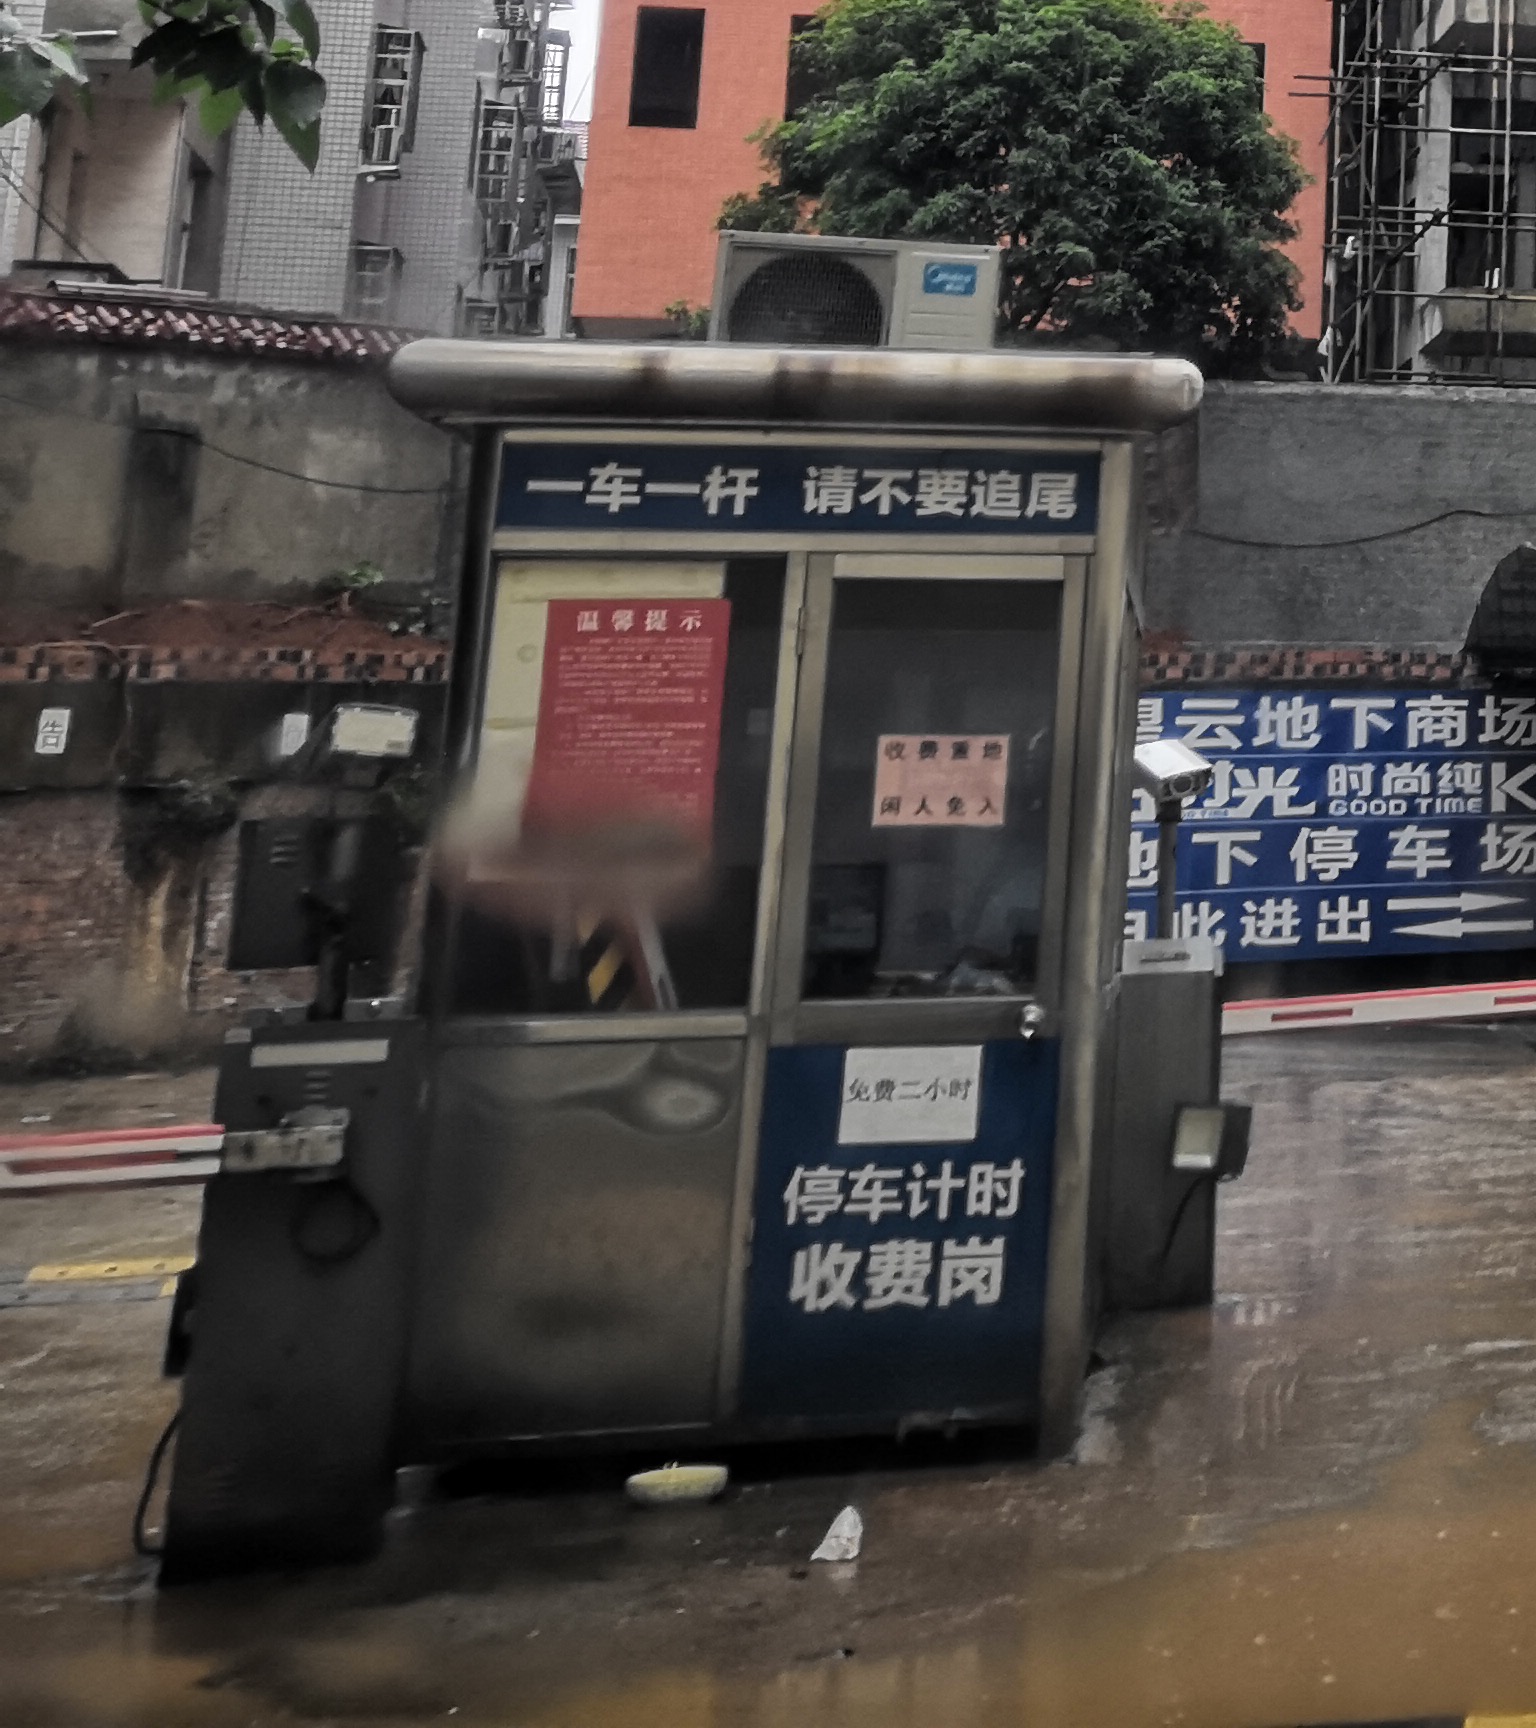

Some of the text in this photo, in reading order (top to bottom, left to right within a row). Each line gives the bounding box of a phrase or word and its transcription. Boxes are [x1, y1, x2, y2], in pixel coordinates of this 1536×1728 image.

[526, 463, 1079, 521] 一车一杆 请不要追尾
[884, 739, 1003, 761] 收费重地
[880, 794, 1000, 817] 闲人免入
[1328, 797, 1483, 816] GOOD TIME
[845, 1076, 973, 1103] 免费二小时
[784, 1158, 1025, 1226] 停车计时
[788, 1235, 1007, 1313] 收费岗
